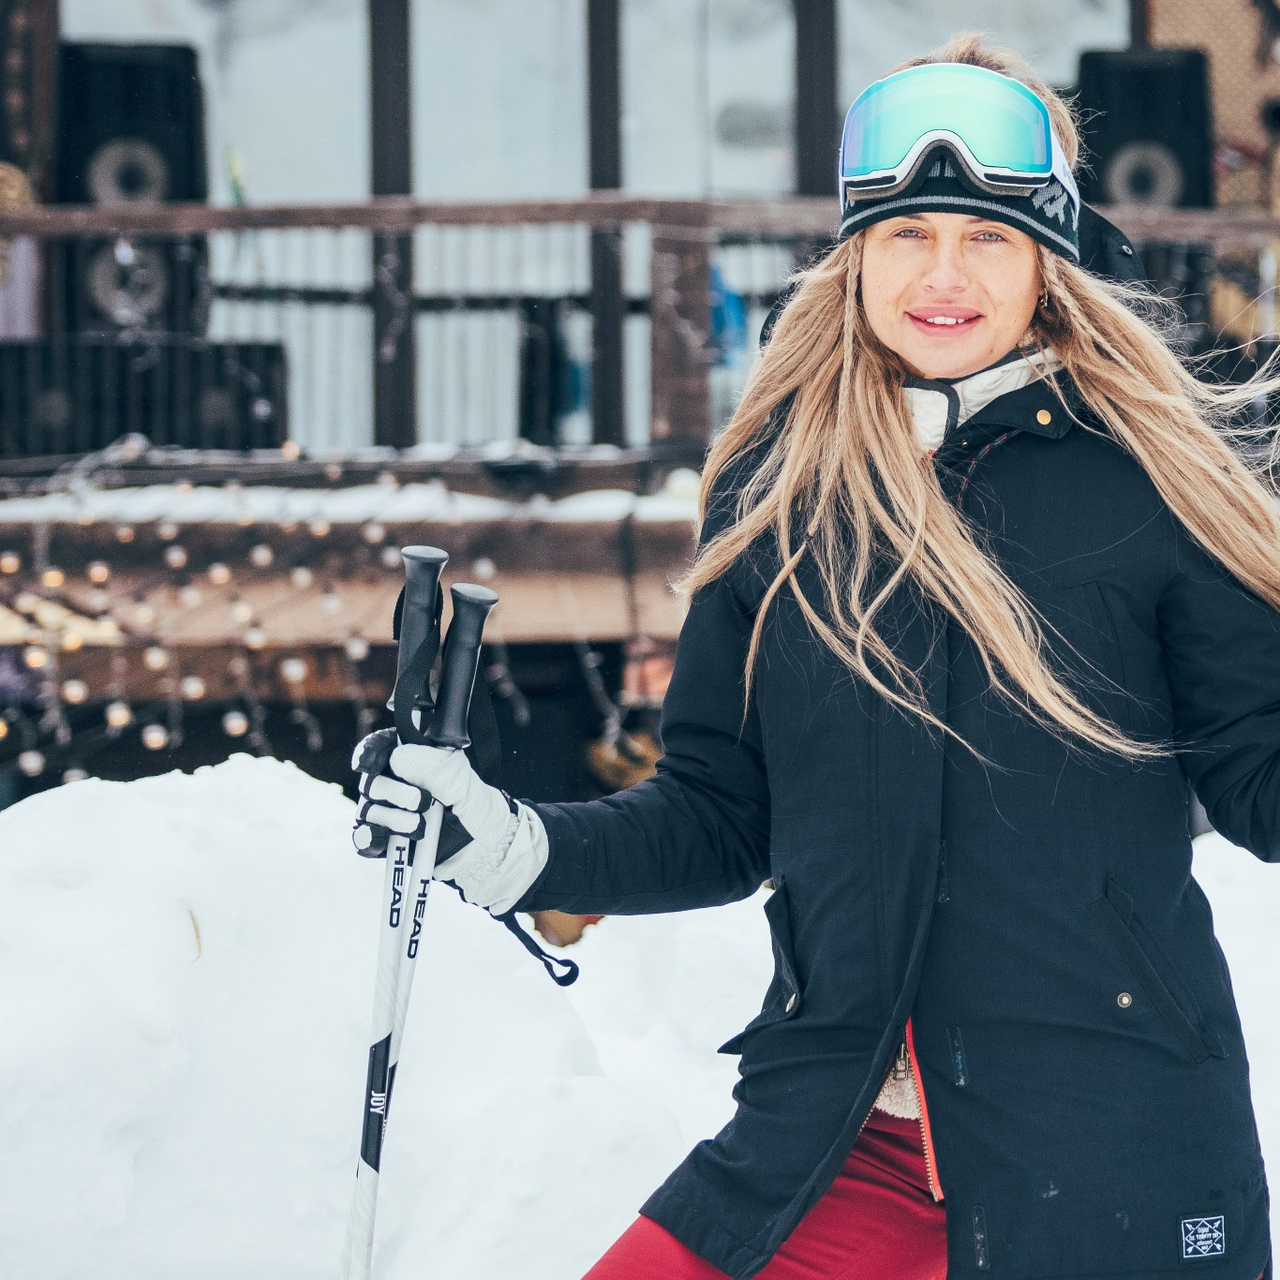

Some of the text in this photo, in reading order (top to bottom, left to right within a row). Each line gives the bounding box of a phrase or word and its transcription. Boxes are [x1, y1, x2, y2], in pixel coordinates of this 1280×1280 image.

[389, 845, 406, 928] HEAD
[407, 878, 431, 959] HEAD
[369, 1090, 386, 1115] JOY
